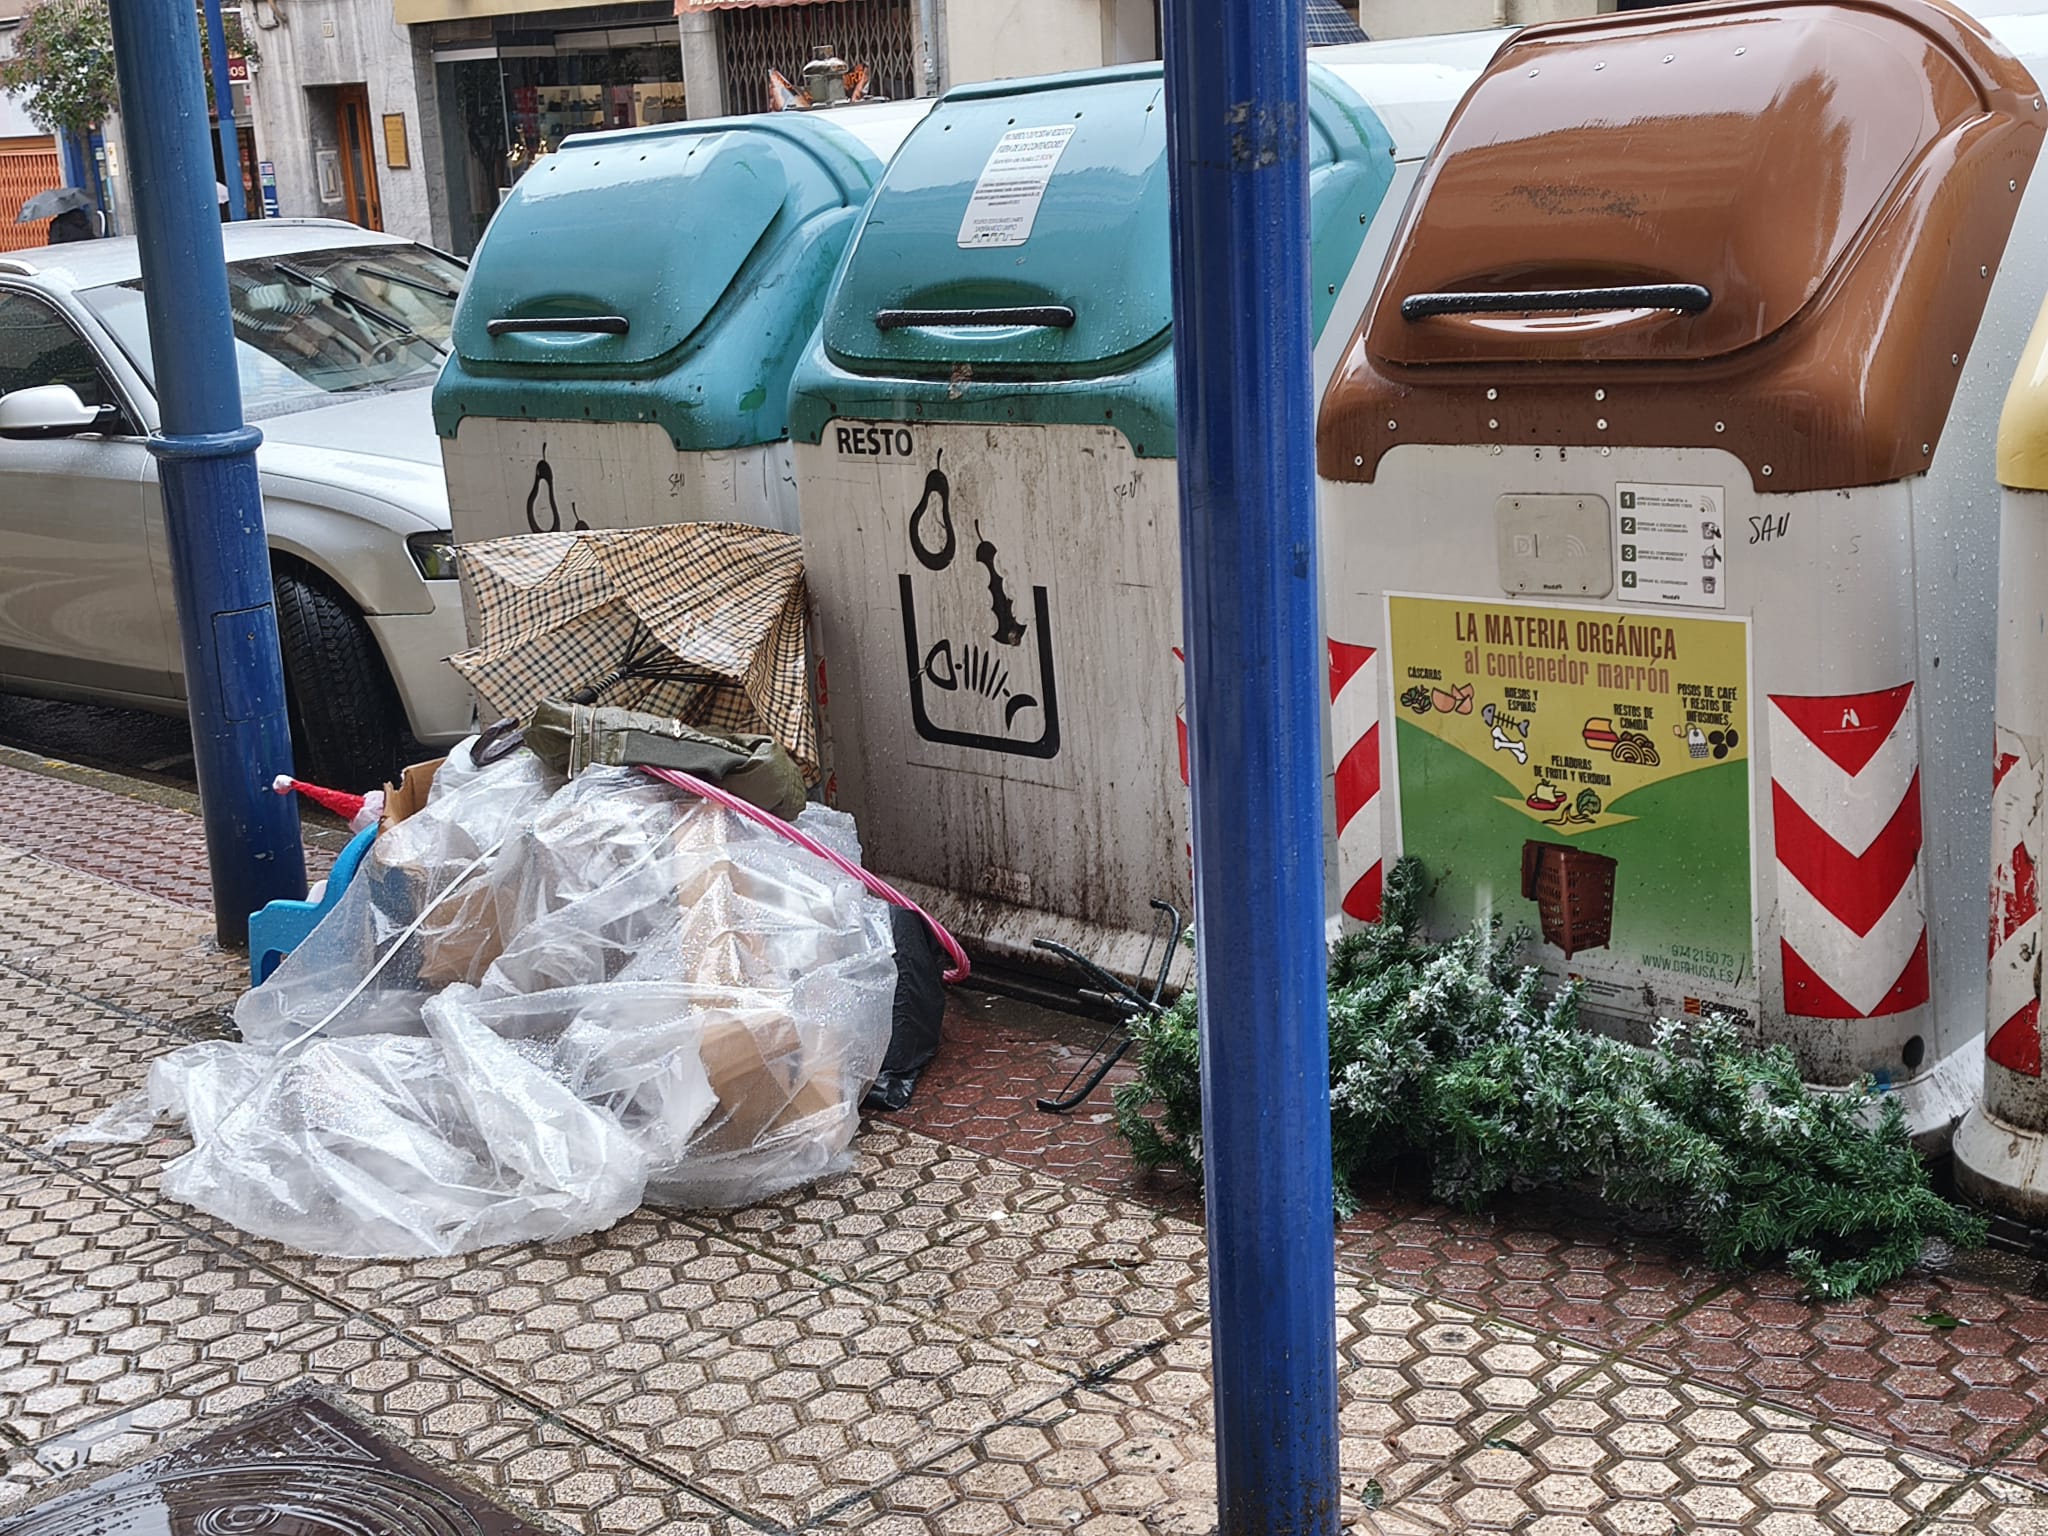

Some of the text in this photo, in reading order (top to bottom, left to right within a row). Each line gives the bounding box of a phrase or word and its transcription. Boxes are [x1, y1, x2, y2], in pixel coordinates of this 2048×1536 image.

[836, 427, 913, 457] RESTO
[1624, 519, 1633, 531] 2
[1749, 512, 1791, 544] SAN
[1624, 547, 1633, 560] 3
[1624, 573, 1633, 585] 4
[1455, 611, 1677, 660] LA MATERIA ORGÁNICA
[1465, 646, 1670, 694] al contenedor marrón
[1533, 690, 1538, 701] Y
[1677, 683, 1701, 697] POSOS
[1704, 685, 1714, 698] DE
[1613, 704, 1654, 719] RESTOS DE
[1682, 697, 1733, 713] Y RESTOS DE
[1620, 717, 1649, 731] COMIDA
[1551, 754, 1592, 771] PELADURAS
[1533, 765, 1612, 786] DE FRUTA Y VERDURA
